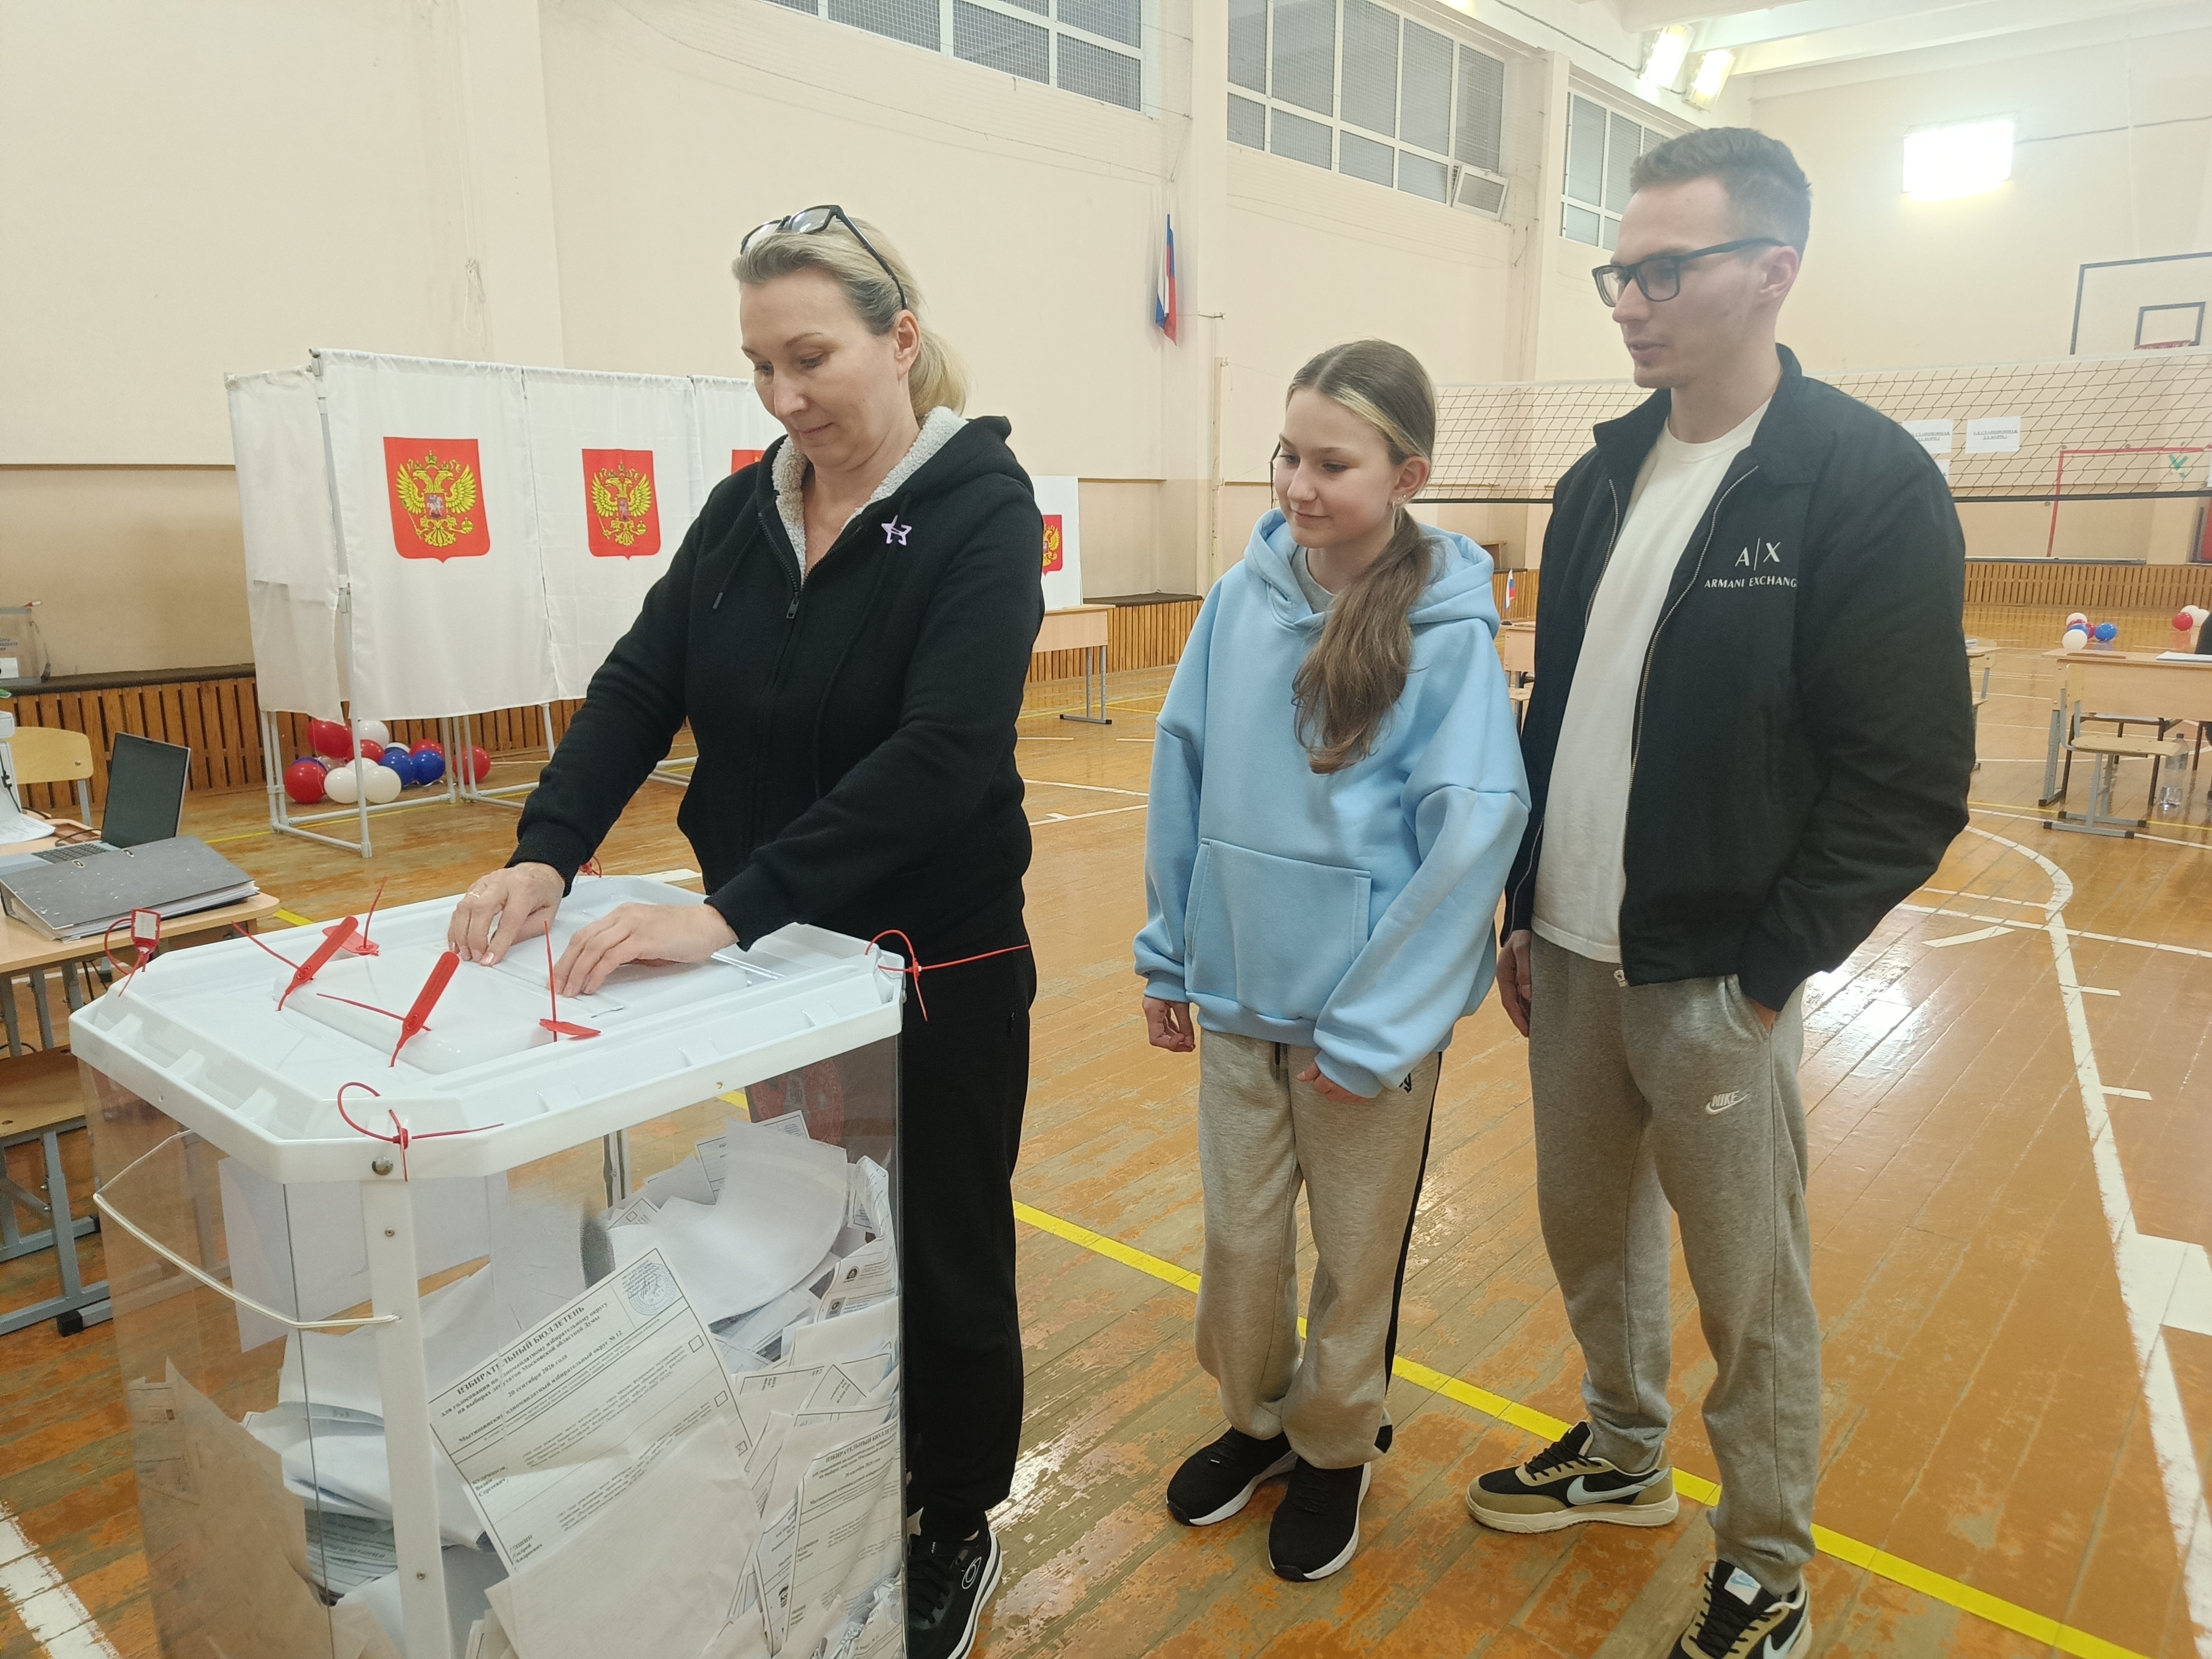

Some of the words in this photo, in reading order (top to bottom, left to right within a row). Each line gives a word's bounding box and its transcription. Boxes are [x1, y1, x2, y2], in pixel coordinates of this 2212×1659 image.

[1704, 578, 1745, 589] ARMANI
[1749, 575, 1797, 588] EXCHANG
[1711, 1090, 1739, 1107] NIKE
[532, 1305, 585, 1343] БЮЛЛЕТЕНЬ
[452, 1382, 490, 1409] голосования
[500, 1345, 545, 1378] дномандатному
[545, 1315, 589, 1346] избирательному
[589, 1302, 608, 1317] округу
[465, 1390, 491, 1408] выборах
[521, 1346, 556, 1372] Московской
[555, 1326, 584, 1348] областной
[583, 1315, 600, 1328] Думы
[515, 1372, 542, 1392] сентября
[541, 1362, 555, 1374] 2026
[555, 1354, 568, 1365] года
[505, 1381, 551, 1414] одномандатный
[551, 1352, 592, 1384] избирательный
[592, 1341, 609, 1354] округ
